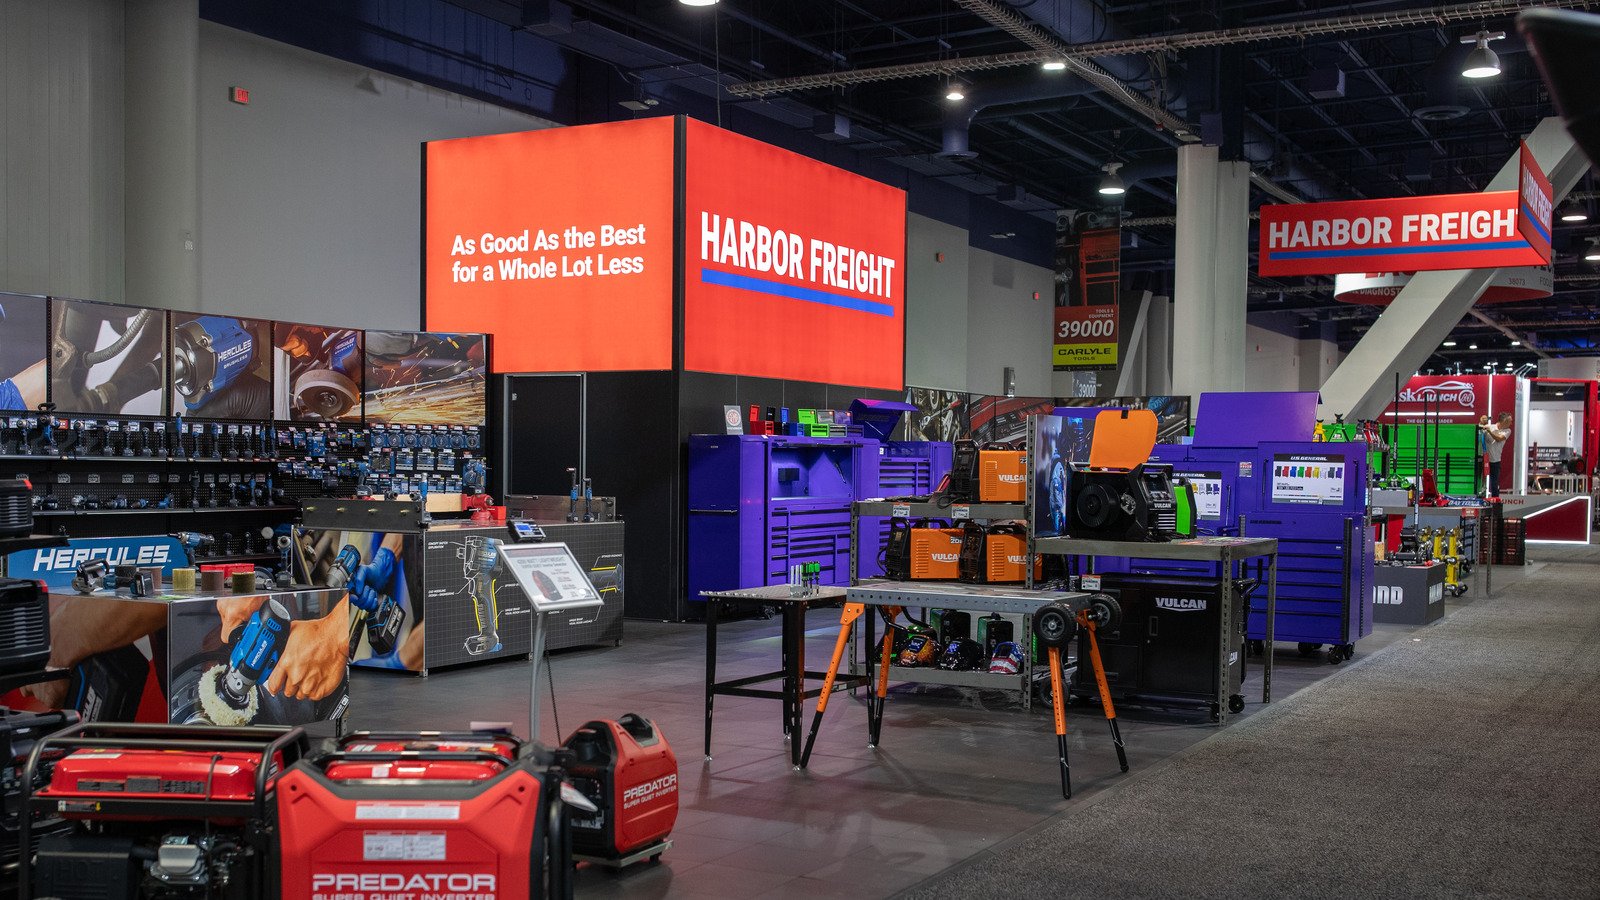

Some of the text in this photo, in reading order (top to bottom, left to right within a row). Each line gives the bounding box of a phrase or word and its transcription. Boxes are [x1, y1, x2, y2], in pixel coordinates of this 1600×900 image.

[451, 223, 646, 256] As Good As the Best
[1269, 208, 1519, 248] HARBOR FREIGH
[701, 211, 895, 298] HARBOR FREIGHT
[452, 253, 644, 283] for a Whole Lot Less
[1058, 319, 1114, 338] 39000
[218, 339, 252, 363] HERCULES
[1058, 347, 1111, 356] CARLYLE
[33, 544, 171, 572] HERCULES
[931, 553, 960, 561] VULCA
[1007, 555, 1027, 563] VULC
[1154, 597, 1207, 609] VULCAN
[623, 773, 677, 802] PREDATOR
[623, 785, 677, 810] SUPER QUIET INVERTER
[312, 873, 496, 892] PREDATOR
